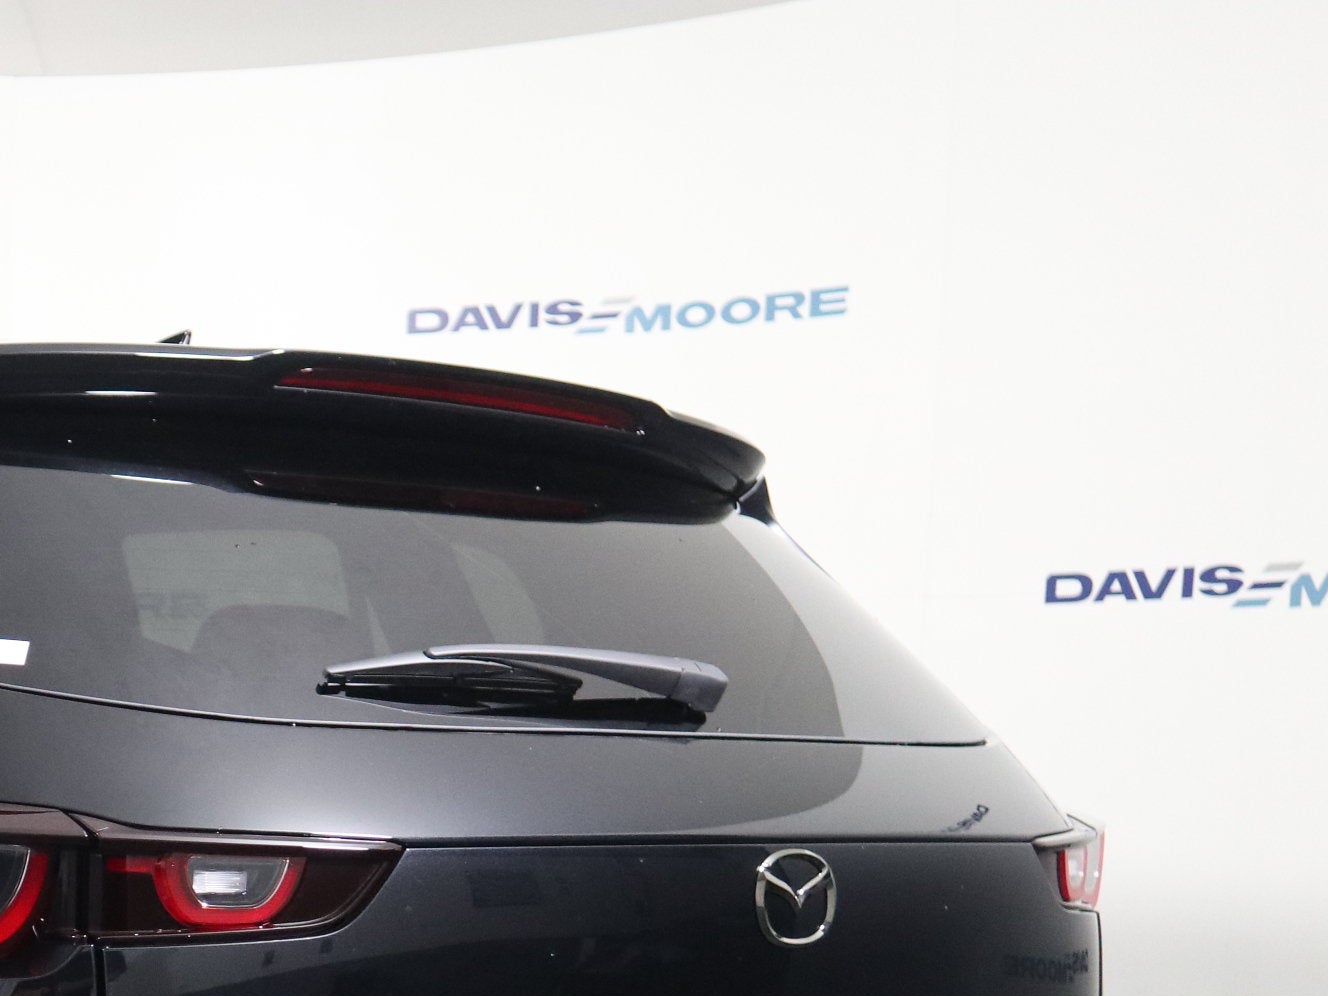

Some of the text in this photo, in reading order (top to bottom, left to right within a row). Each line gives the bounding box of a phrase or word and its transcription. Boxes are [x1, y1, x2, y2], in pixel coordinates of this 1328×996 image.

[406, 285, 850, 334] DAVIS MOORE
[1044, 564, 1246, 604] DAVIS
